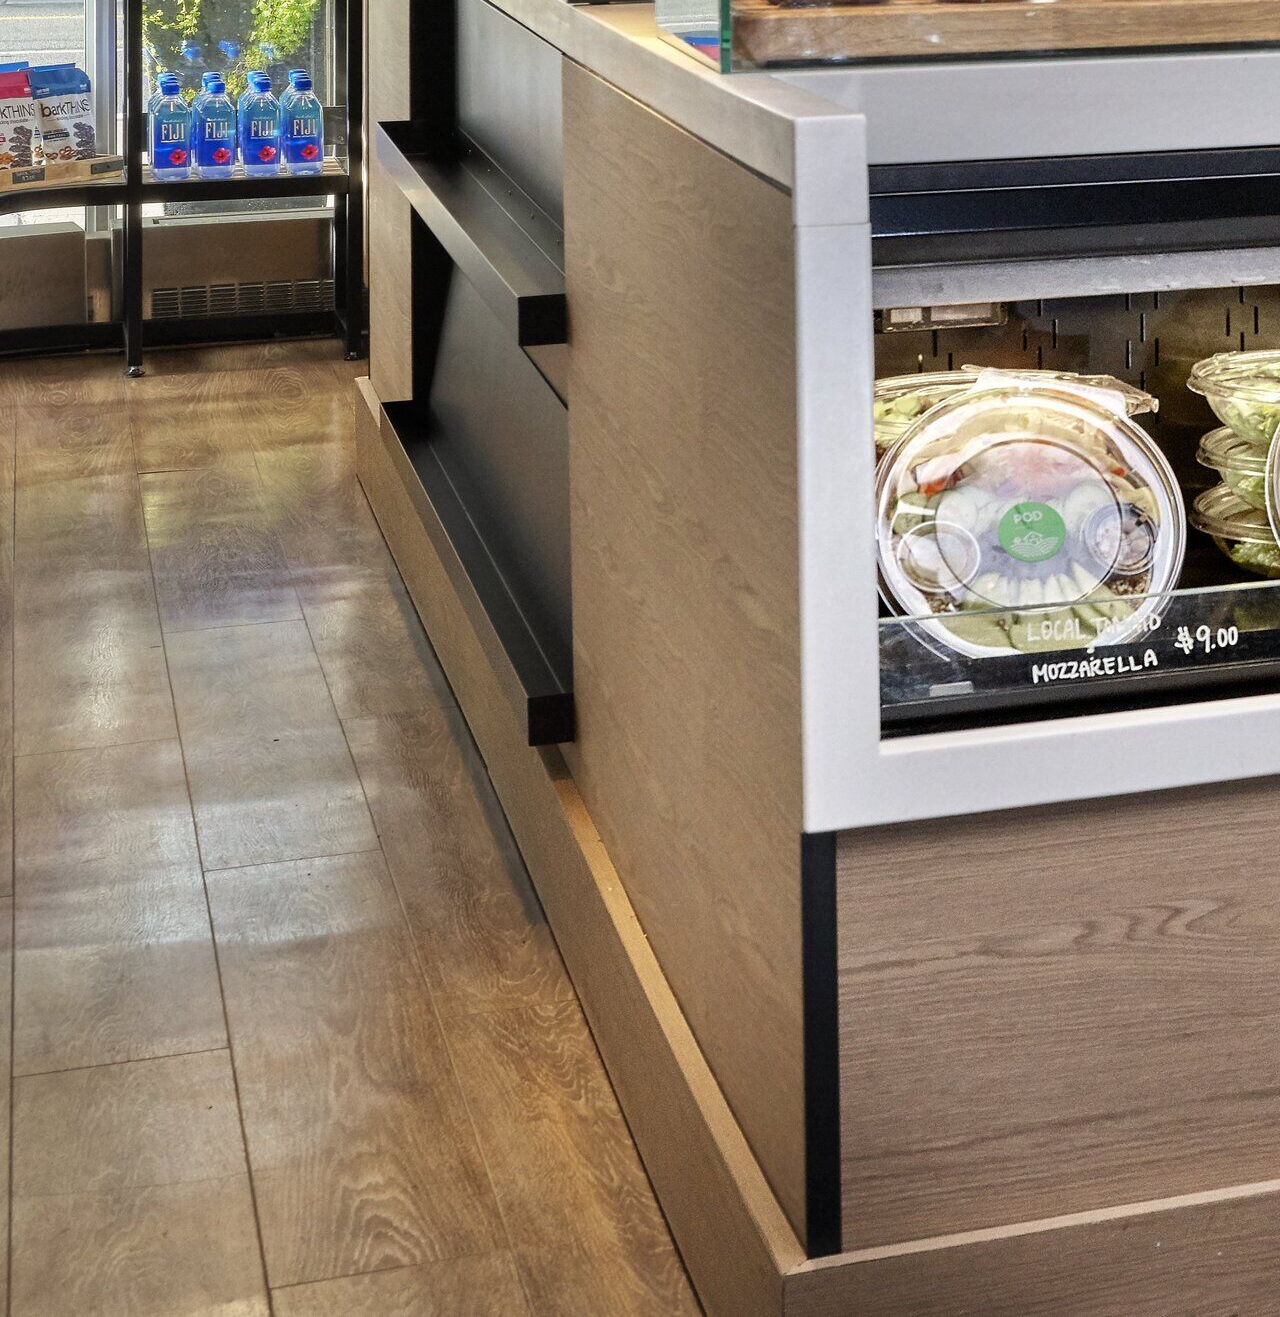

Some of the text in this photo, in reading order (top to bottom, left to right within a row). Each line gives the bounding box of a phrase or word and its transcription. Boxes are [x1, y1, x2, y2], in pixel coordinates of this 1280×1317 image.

[41, 99, 90, 118] barkTHINS
[161, 123, 184, 141] FIJI
[205, 122, 229, 138] FIJI
[251, 120, 274, 137] FIJI
[293, 119, 316, 135] FIJI
[1012, 509, 1044, 524] POD
[1026, 616, 1087, 643] LOCAL
[1174, 624, 1240, 655] $9.00
[1031, 648, 1159, 684] MOZZARELLA
